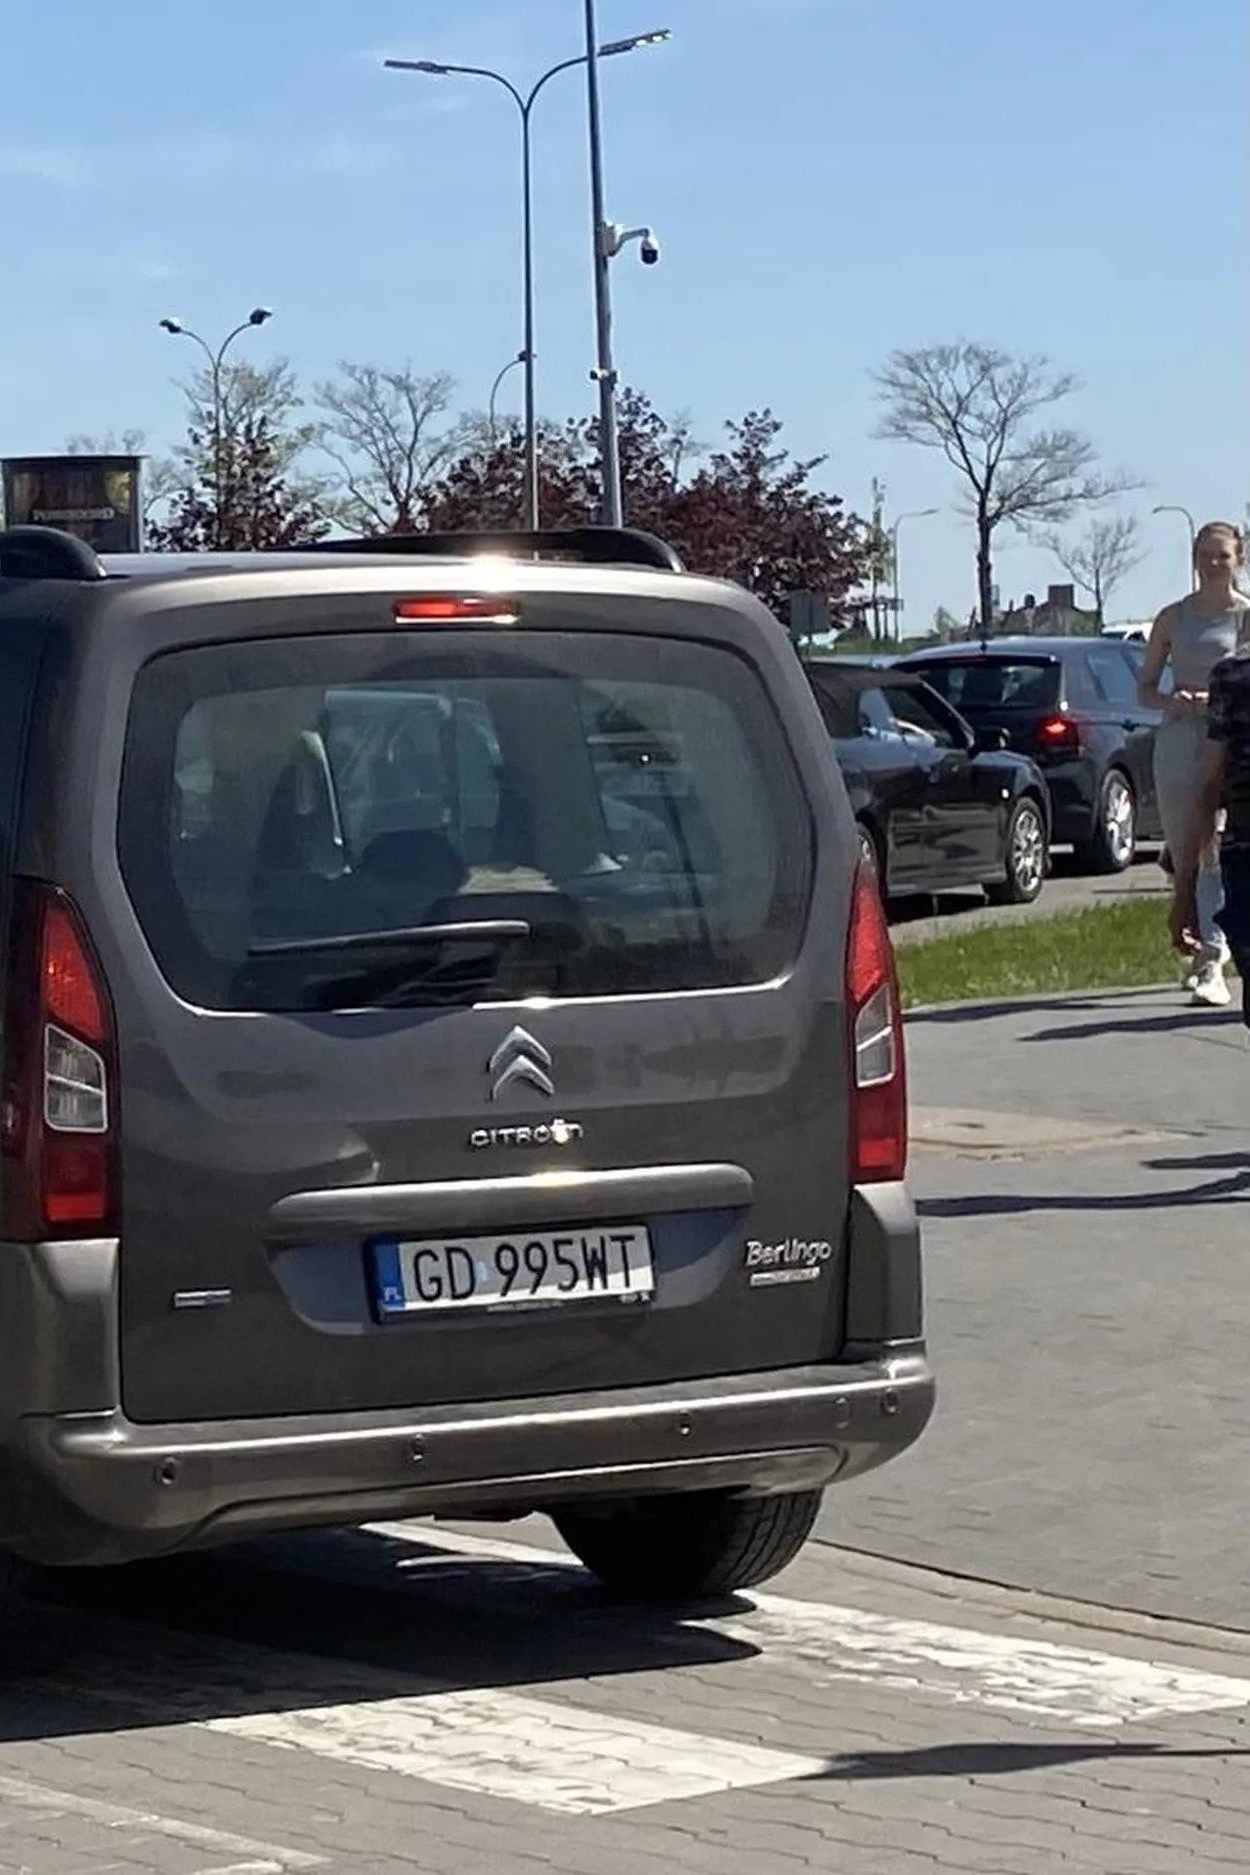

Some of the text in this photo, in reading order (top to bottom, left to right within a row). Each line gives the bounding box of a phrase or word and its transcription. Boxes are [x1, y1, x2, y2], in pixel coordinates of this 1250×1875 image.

[413, 1234, 636, 1302] GD 995WT
[746, 1238, 832, 1266] Berlingo
